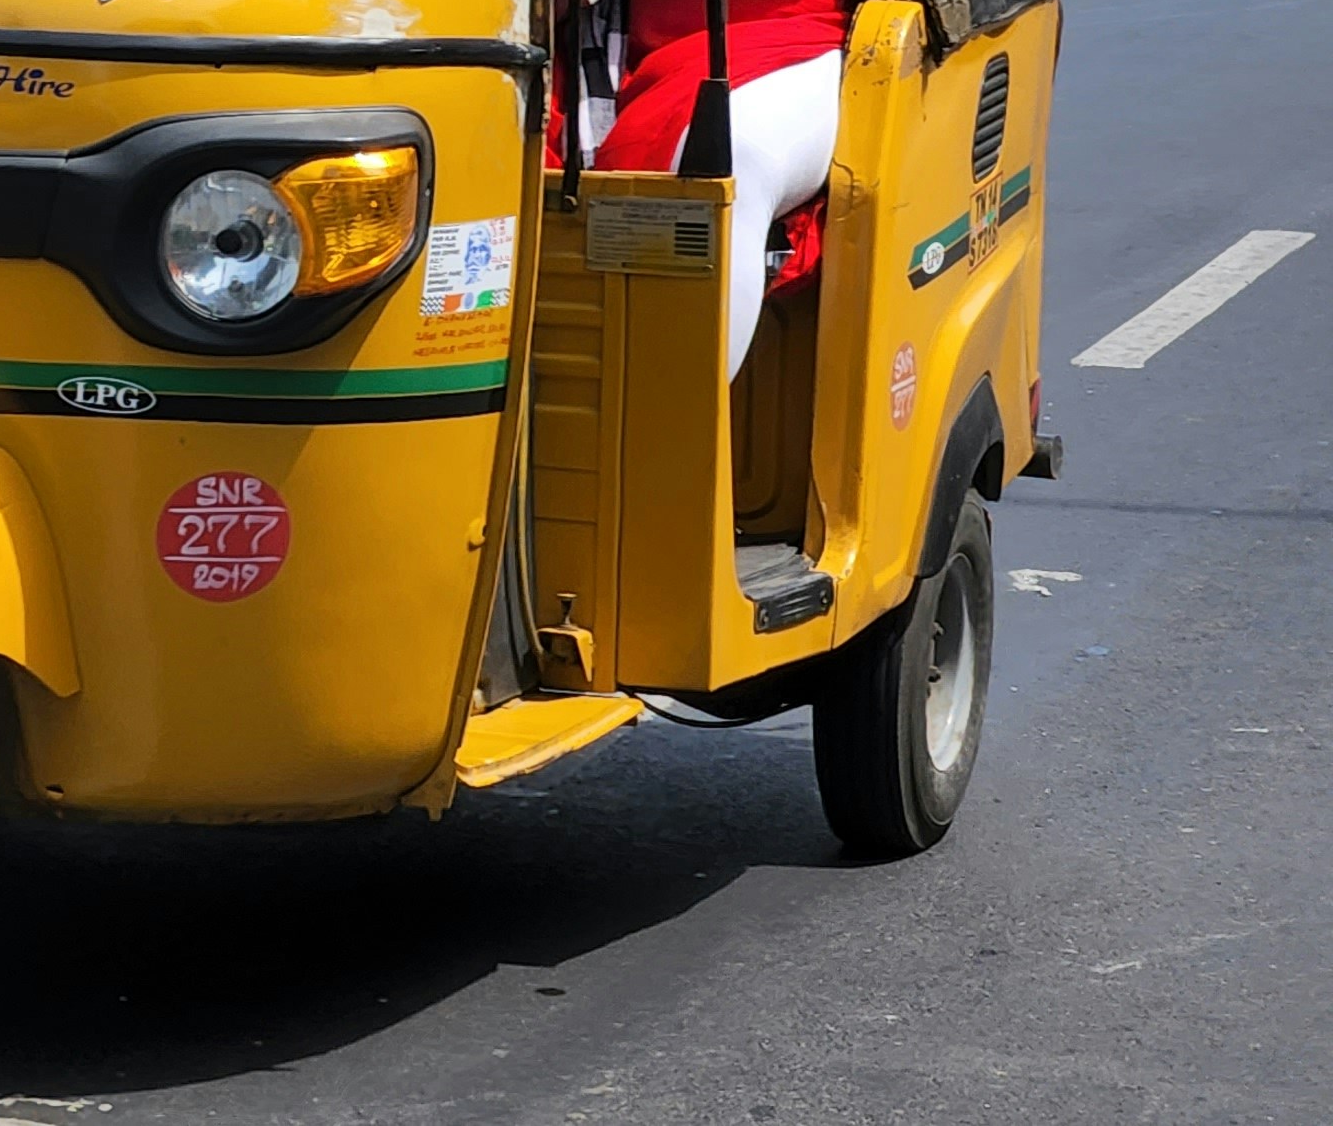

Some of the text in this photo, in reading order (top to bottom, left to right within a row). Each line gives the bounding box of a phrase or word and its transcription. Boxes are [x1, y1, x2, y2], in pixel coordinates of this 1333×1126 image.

[73, 379, 140, 410] LPG
[195, 477, 264, 507] SNR
[176, 514, 278, 556] 277
[193, 563, 260, 592] 2019
